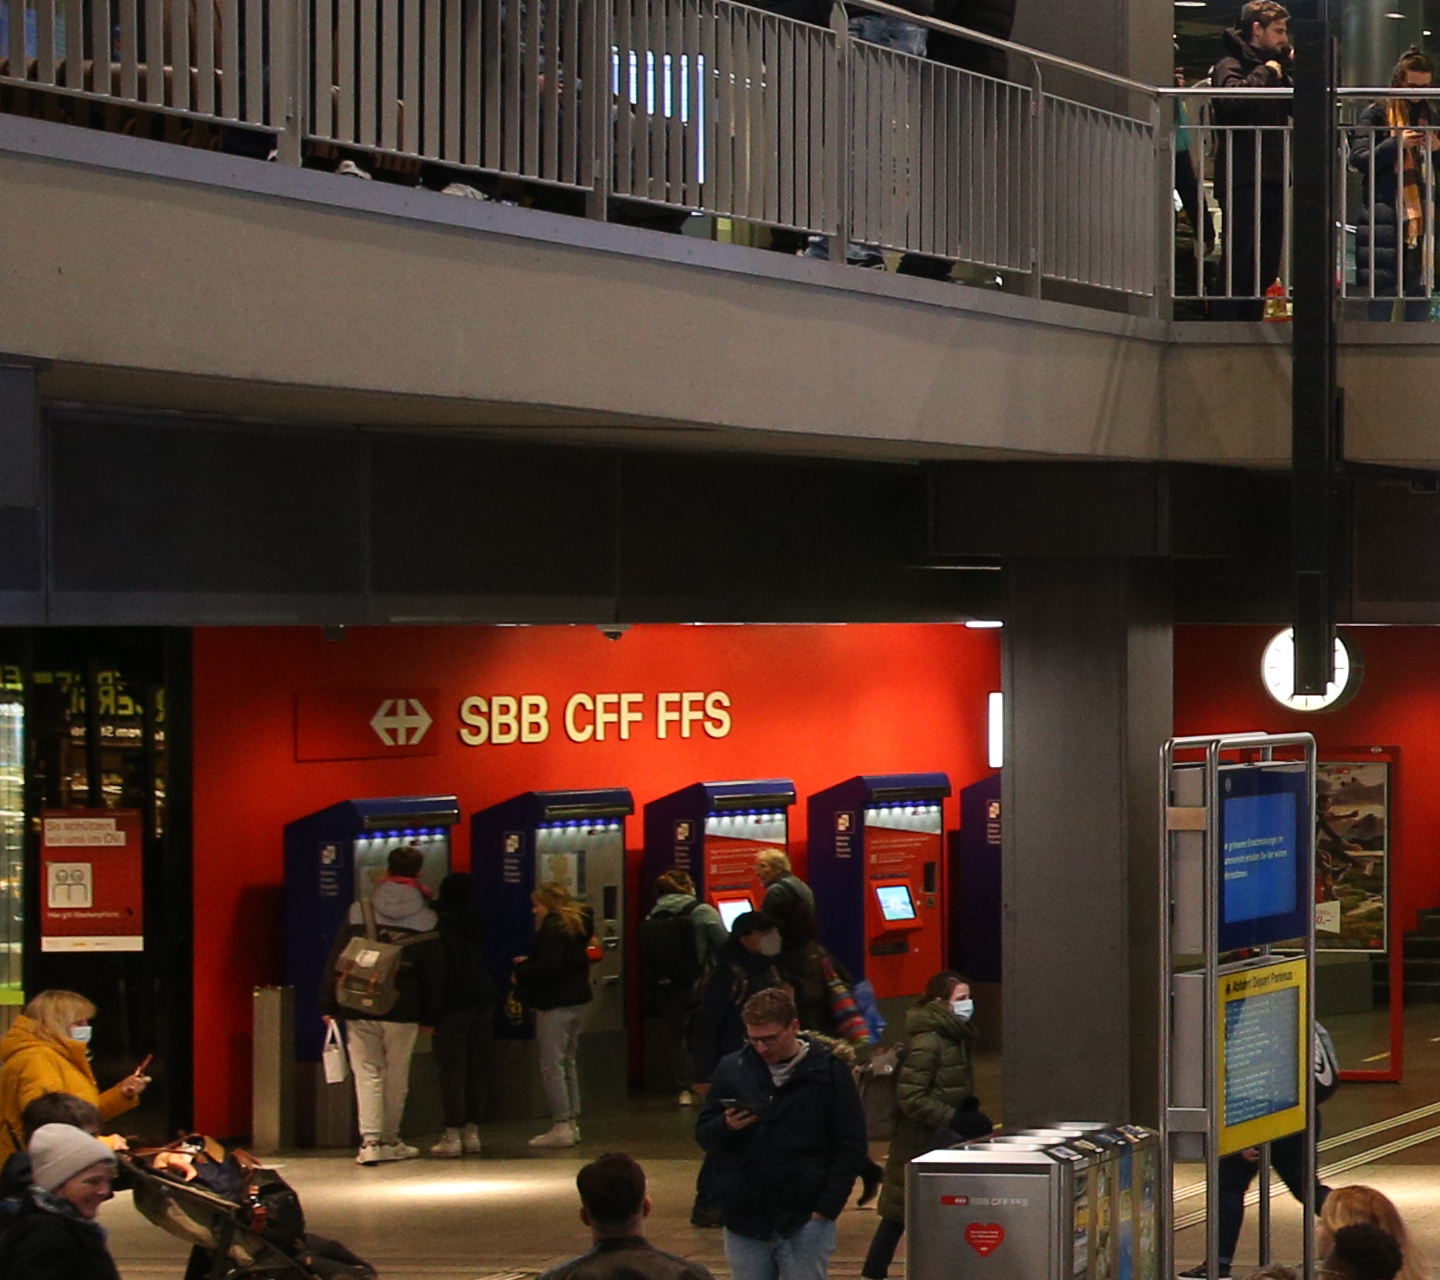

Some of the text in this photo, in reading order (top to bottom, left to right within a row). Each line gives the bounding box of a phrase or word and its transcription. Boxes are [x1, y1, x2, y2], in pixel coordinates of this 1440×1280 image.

[458, 691, 732, 747] SBB CFF FFS
